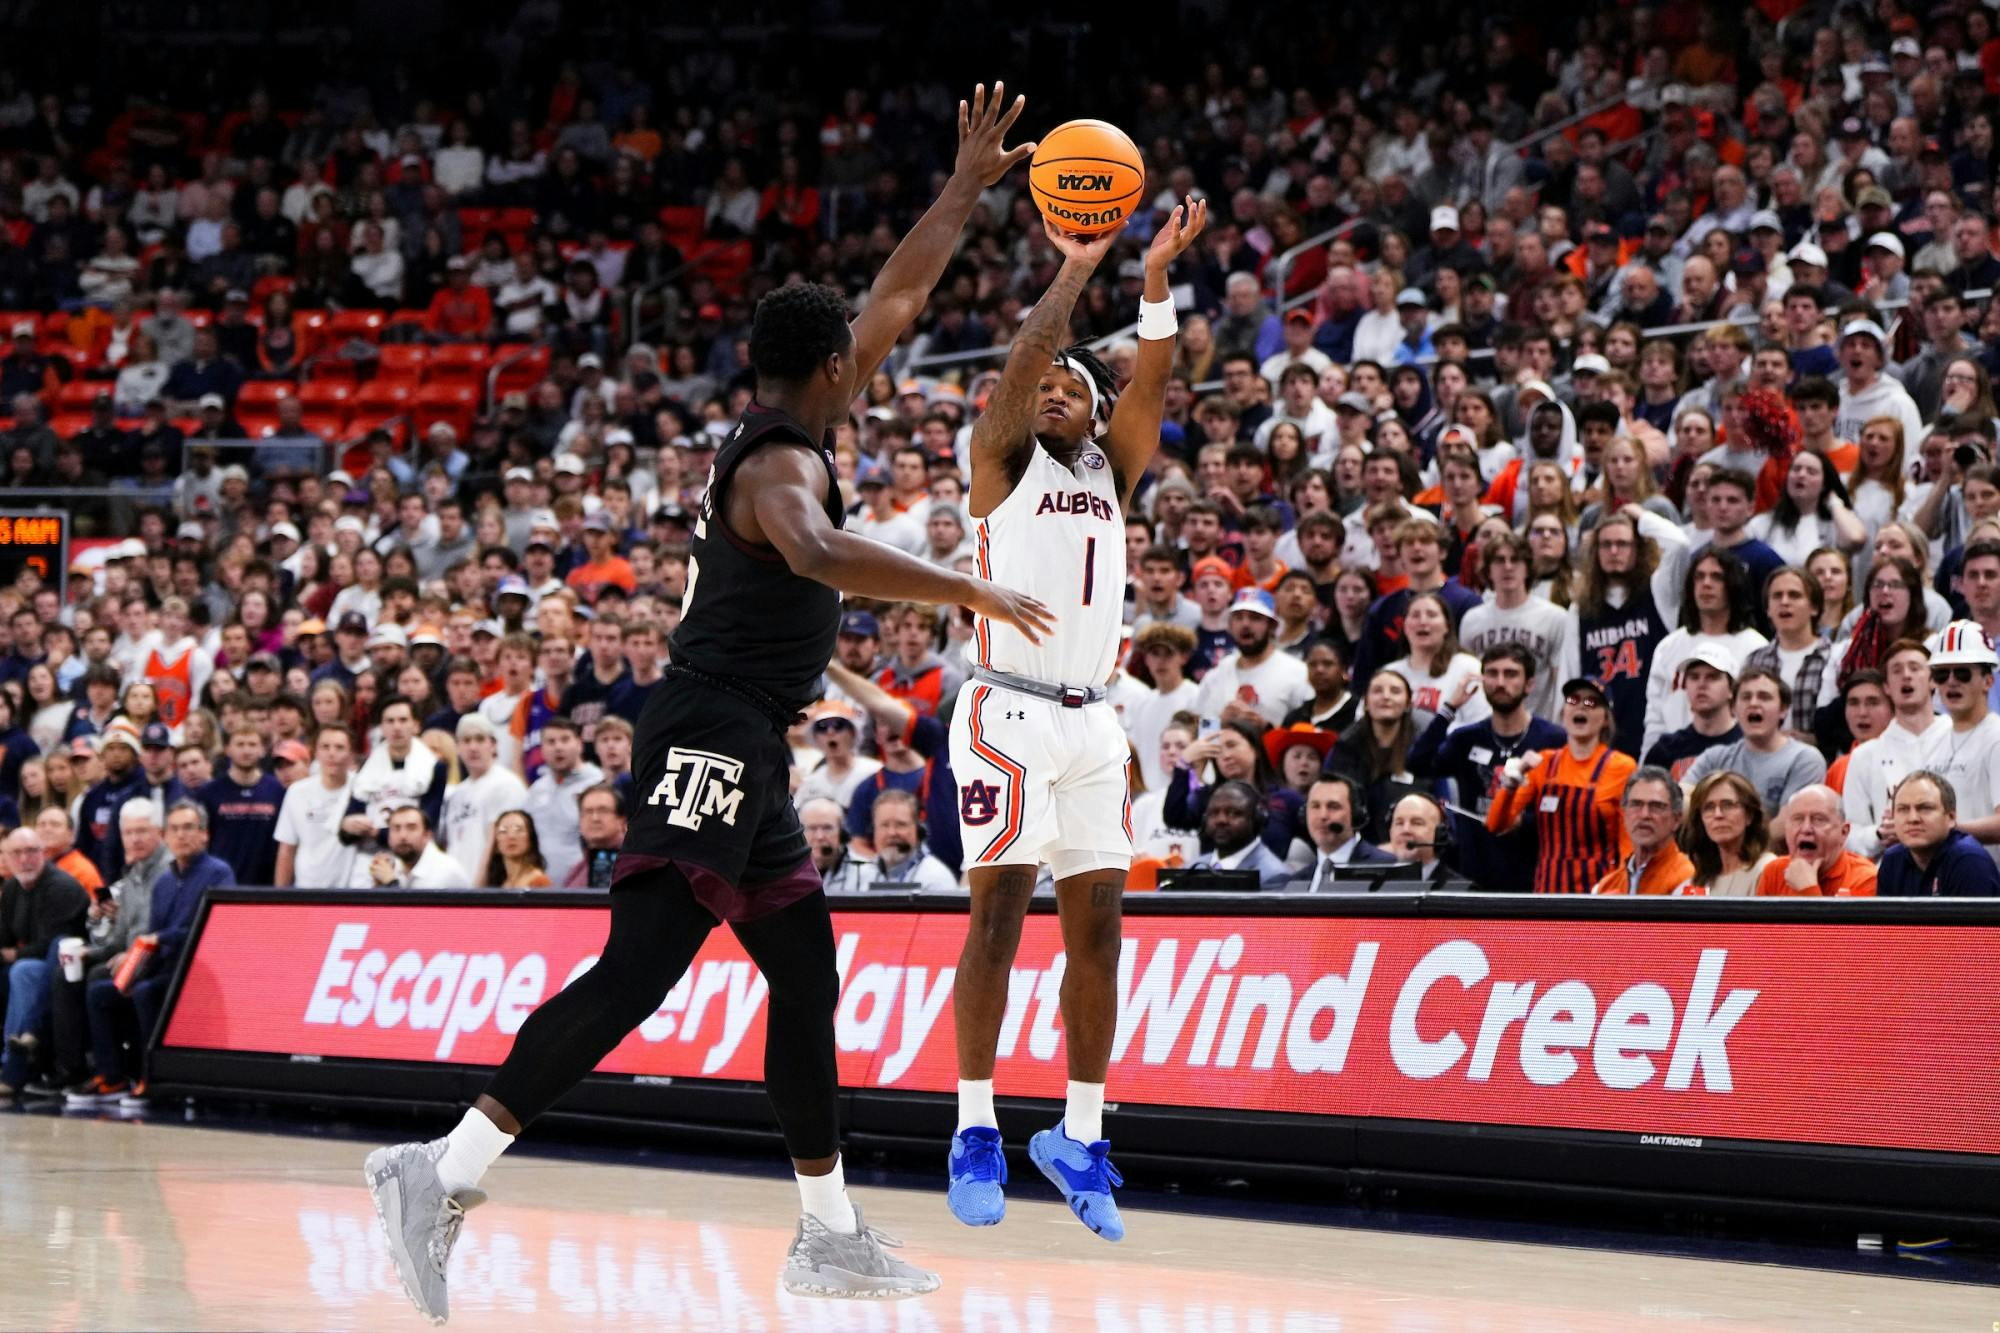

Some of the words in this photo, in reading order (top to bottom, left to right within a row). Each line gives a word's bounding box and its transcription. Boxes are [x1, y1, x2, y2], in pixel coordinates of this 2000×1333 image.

[1057, 174, 1113, 192] NCAA
[1047, 201, 1122, 226] Wilson
[1082, 536, 1096, 606] 1
[1597, 640, 1643, 683] 34
[303, 922, 545, 1060] Escape
[561, 954, 770, 1075] ery
[1108, 932, 1382, 1076] Wind
[1388, 938, 1762, 1093] Creek
[1640, 1135, 1703, 1148] DAKTRONICS
